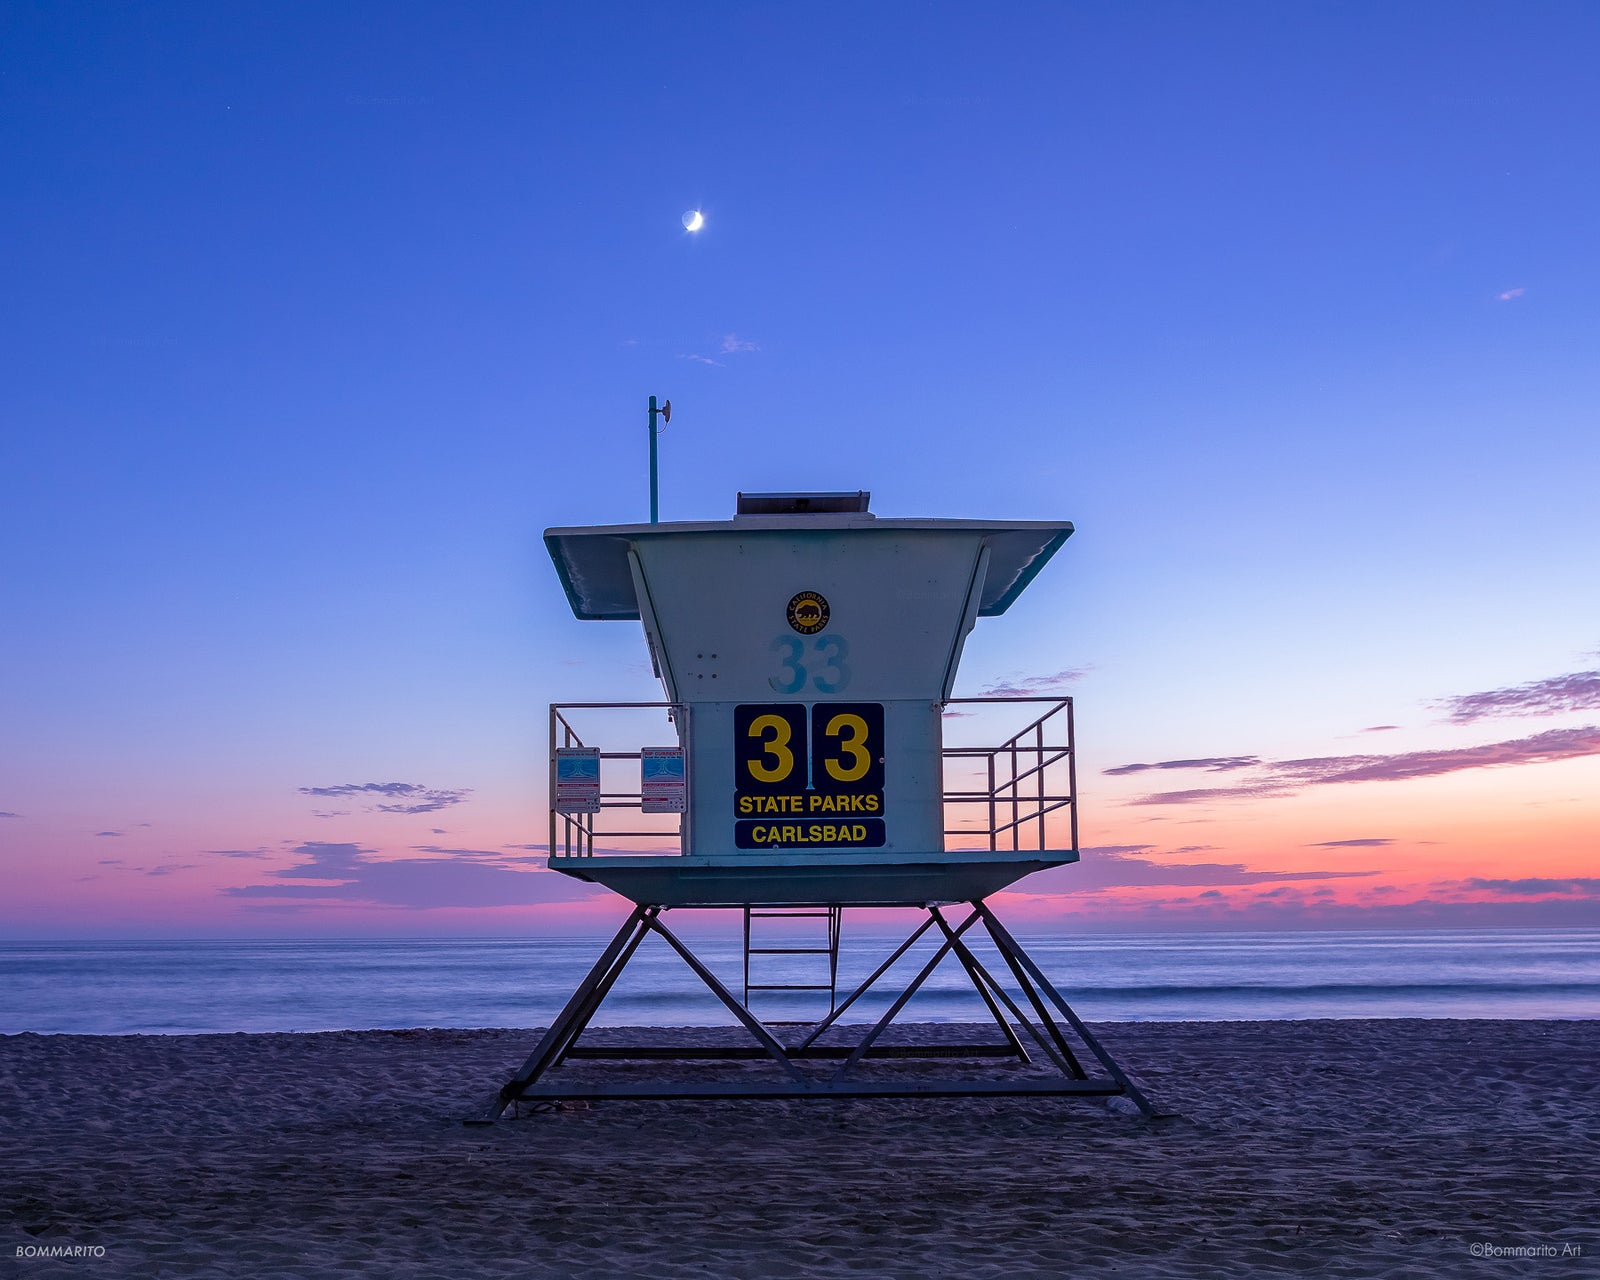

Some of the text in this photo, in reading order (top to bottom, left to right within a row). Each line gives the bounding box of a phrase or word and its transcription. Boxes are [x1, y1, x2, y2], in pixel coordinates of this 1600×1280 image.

[789, 592, 828, 611] CALIFORNIA
[788, 615, 829, 633] STATE PARKS
[768, 634, 852, 694] 33
[739, 794, 879, 813] STATE PARKS
[752, 825, 867, 843] CARLSBAD
